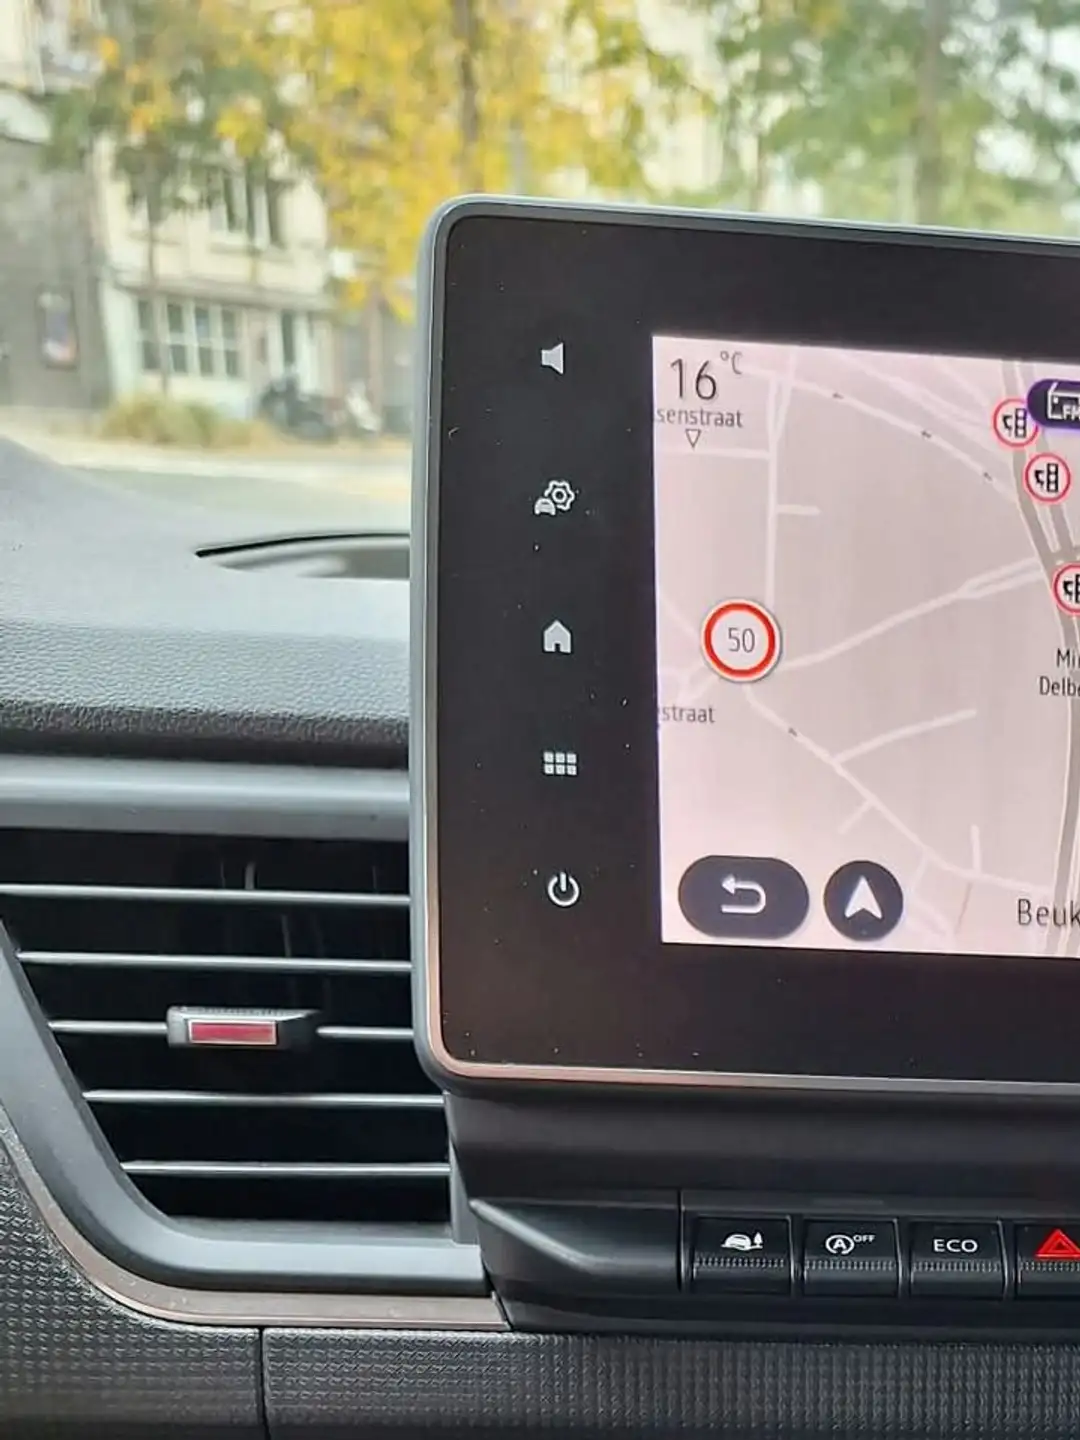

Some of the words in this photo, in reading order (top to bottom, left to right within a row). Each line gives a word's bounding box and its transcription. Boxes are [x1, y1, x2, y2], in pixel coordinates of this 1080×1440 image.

[669, 357, 717, 401] 16
[726, 626, 756, 654] 50
[661, 704, 716, 724] straat
[853, 1234, 876, 1243] OFF
[933, 1238, 979, 1253] ECO
